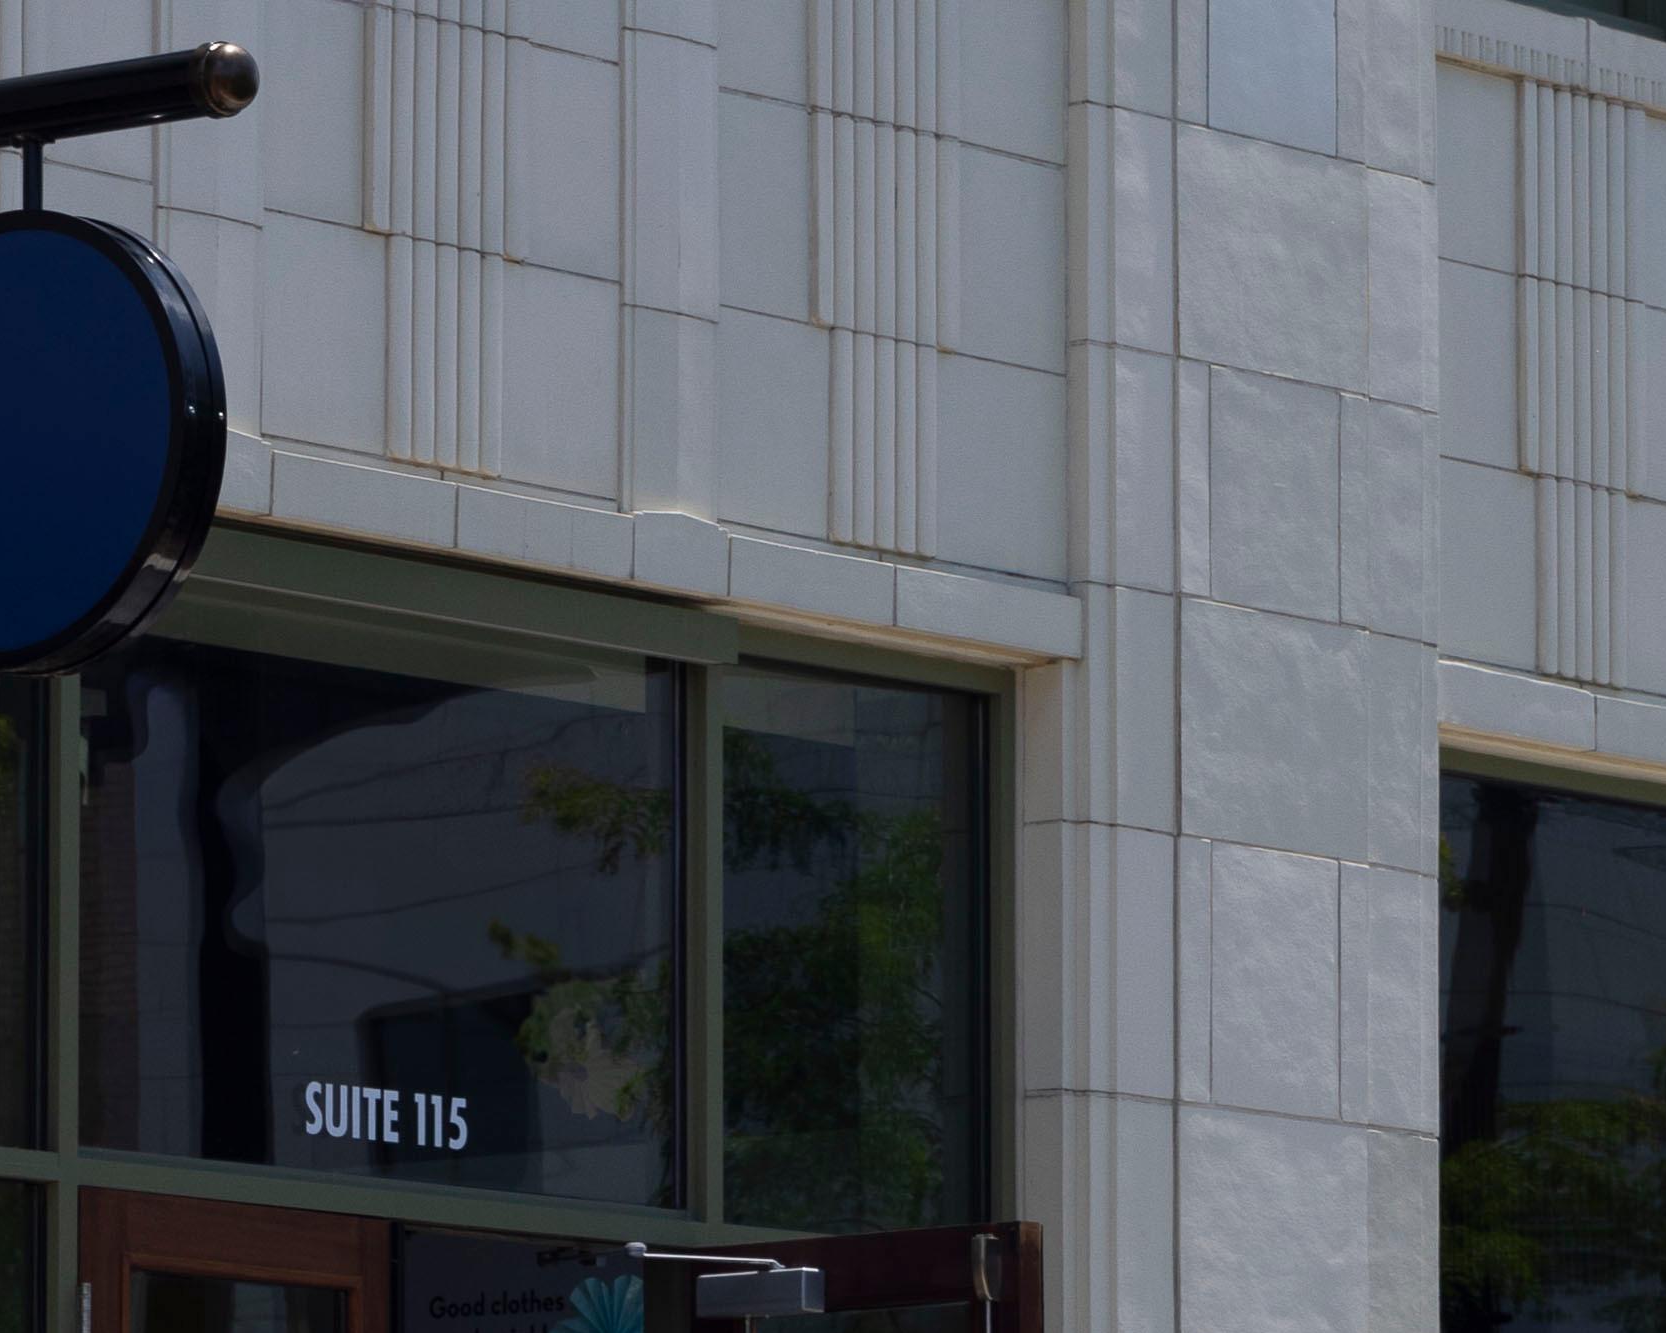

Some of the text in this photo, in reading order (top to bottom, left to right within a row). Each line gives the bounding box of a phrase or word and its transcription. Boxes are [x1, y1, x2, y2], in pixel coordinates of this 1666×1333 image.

[304, 1080, 469, 1151] SUITE 115
[429, 1288, 565, 1319] Good clothes
